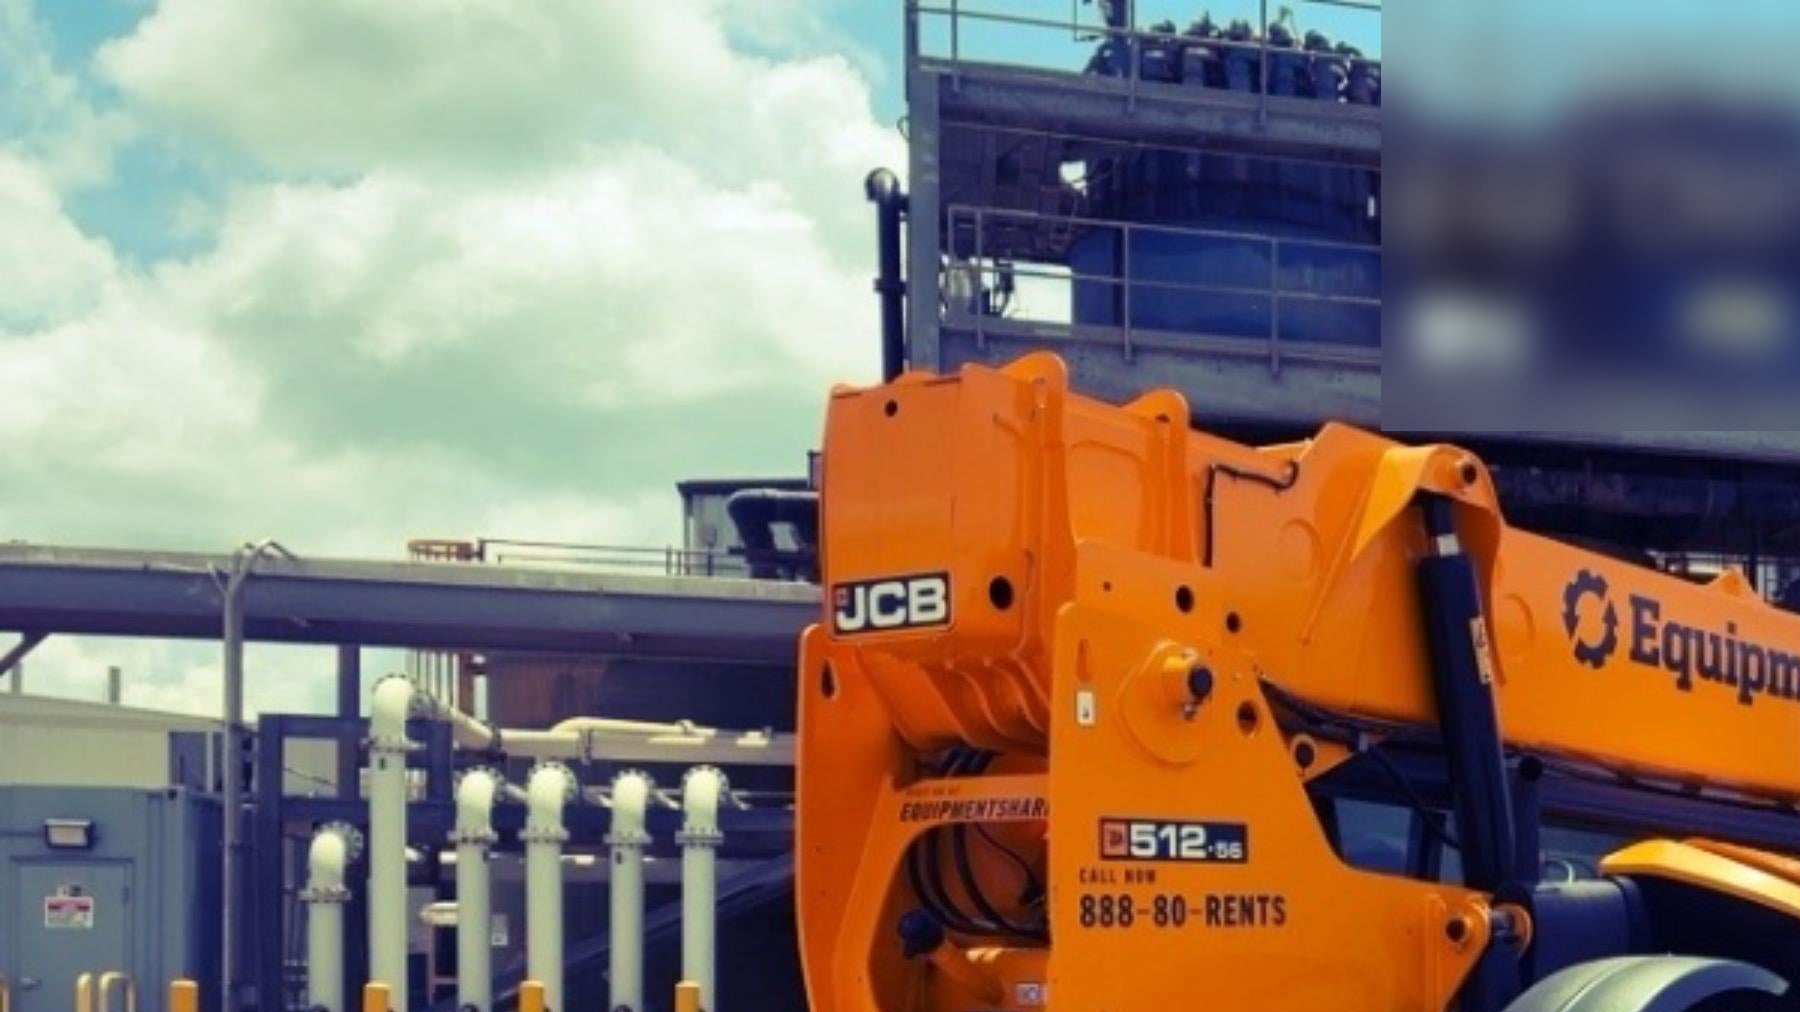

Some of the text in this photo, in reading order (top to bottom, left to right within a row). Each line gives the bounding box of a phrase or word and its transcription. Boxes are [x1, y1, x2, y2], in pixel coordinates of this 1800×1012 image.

[836, 578, 946, 631] JCB
[1079, 868, 1117, 884] CALL
[1080, 893, 1286, 928] 888-80-RENTS
